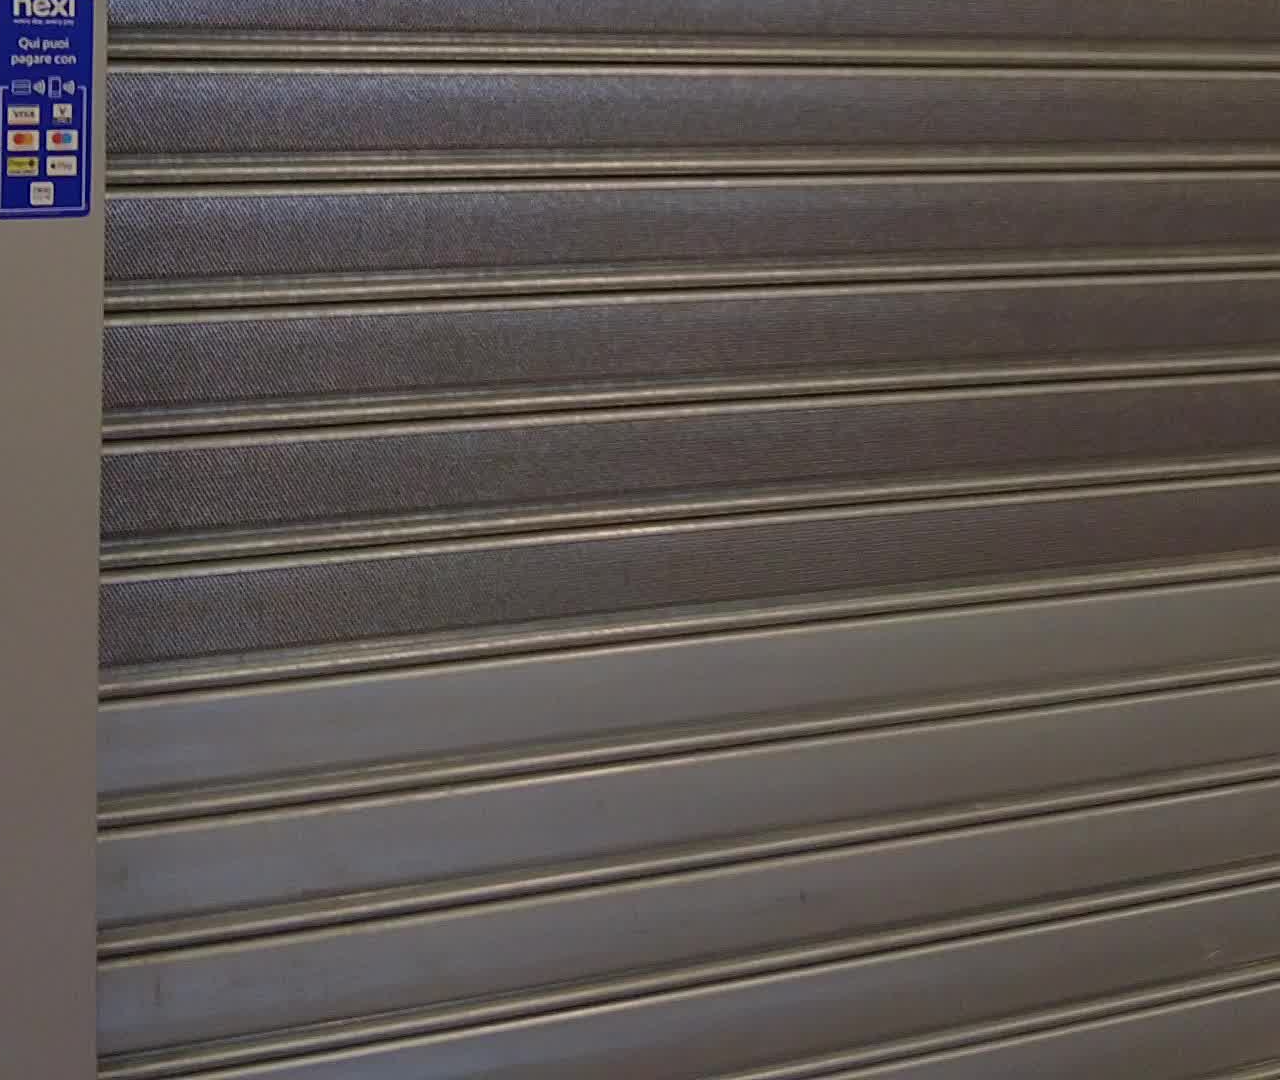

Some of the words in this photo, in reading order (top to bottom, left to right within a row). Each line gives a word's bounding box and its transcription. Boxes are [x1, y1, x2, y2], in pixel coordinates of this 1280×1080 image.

[18, 36, 40, 51] Qui
[42, 37, 69, 51] puoi
[10, 54, 52, 67] pagare
[54, 54, 77, 65] con
